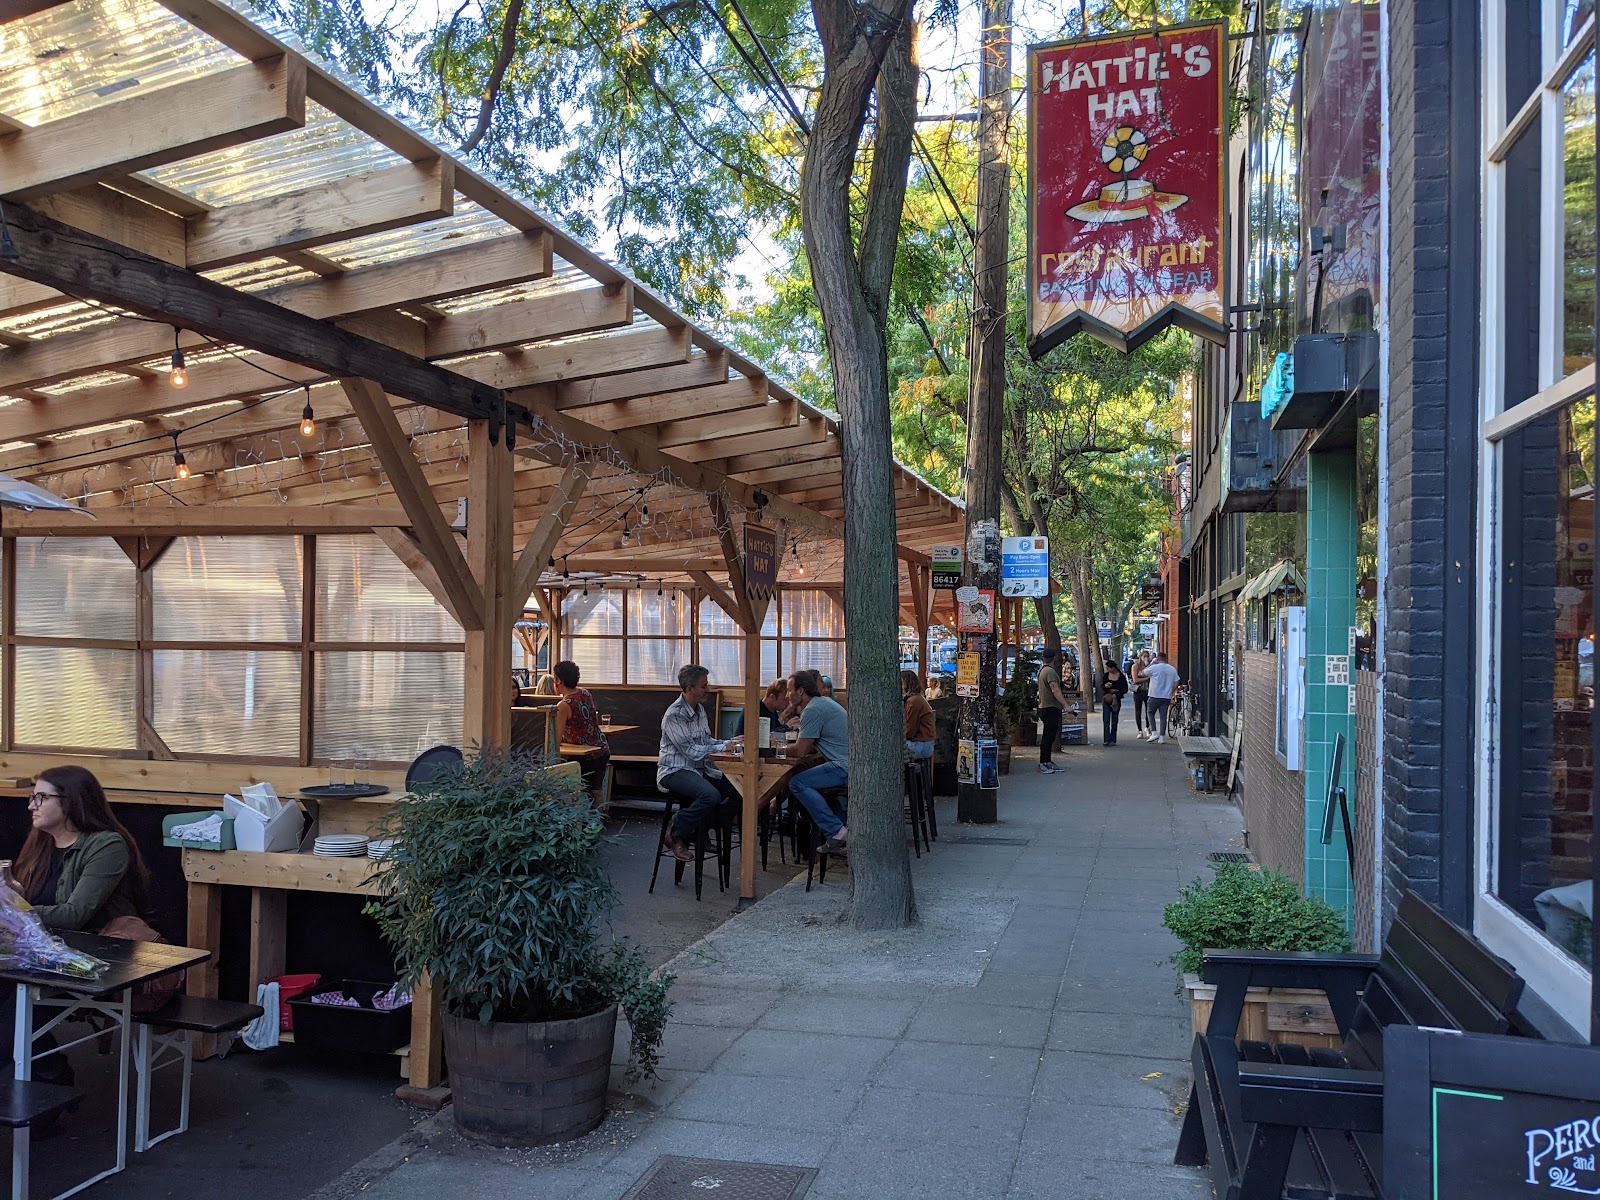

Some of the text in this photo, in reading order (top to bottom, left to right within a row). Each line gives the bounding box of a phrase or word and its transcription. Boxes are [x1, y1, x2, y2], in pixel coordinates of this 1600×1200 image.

[1088, 87, 1162, 121] HAT
[753, 555, 769, 574] HAT
[1010, 566, 1015, 574] 2
[933, 575, 959, 584] 86417
[1573, 1154, 1595, 1171] and
